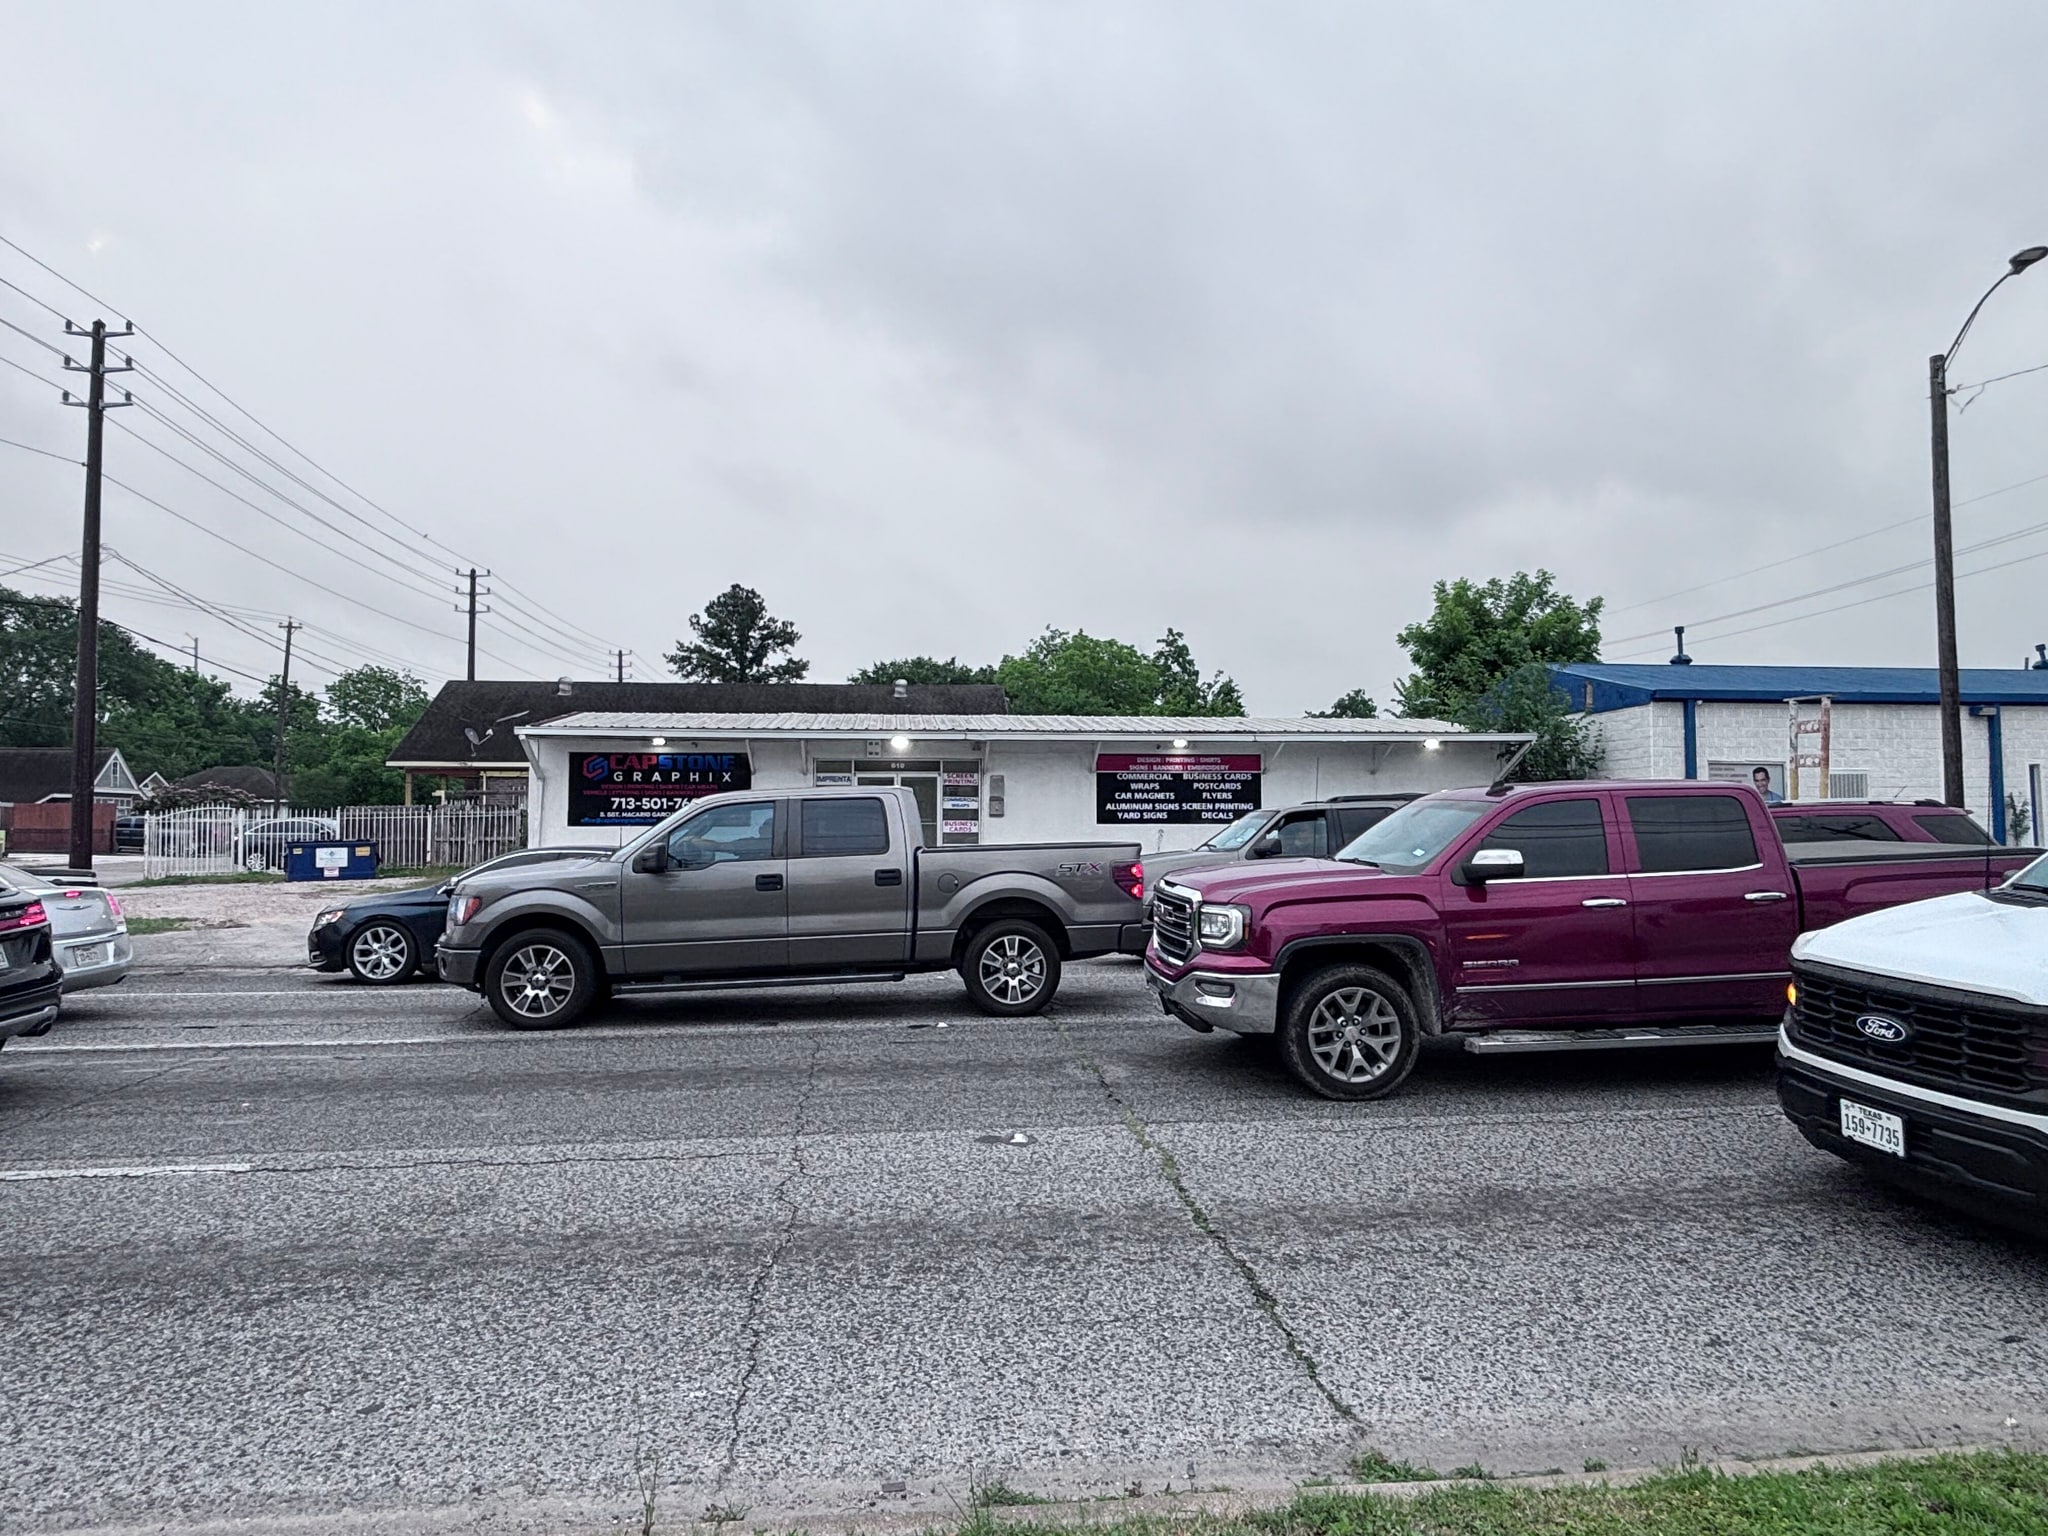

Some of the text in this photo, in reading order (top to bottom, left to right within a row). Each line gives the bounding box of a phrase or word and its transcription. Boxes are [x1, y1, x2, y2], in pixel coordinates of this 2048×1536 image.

[610, 755, 735, 770] CAPSTONE
[614, 772, 732, 782] GRAPHIX
[610, 797, 692, 810] 713-501-76
[1058, 862, 1101, 873] STX
[1864, 1019, 1896, 1039] Ford
[1858, 1107, 1882, 1120] TEXAS
